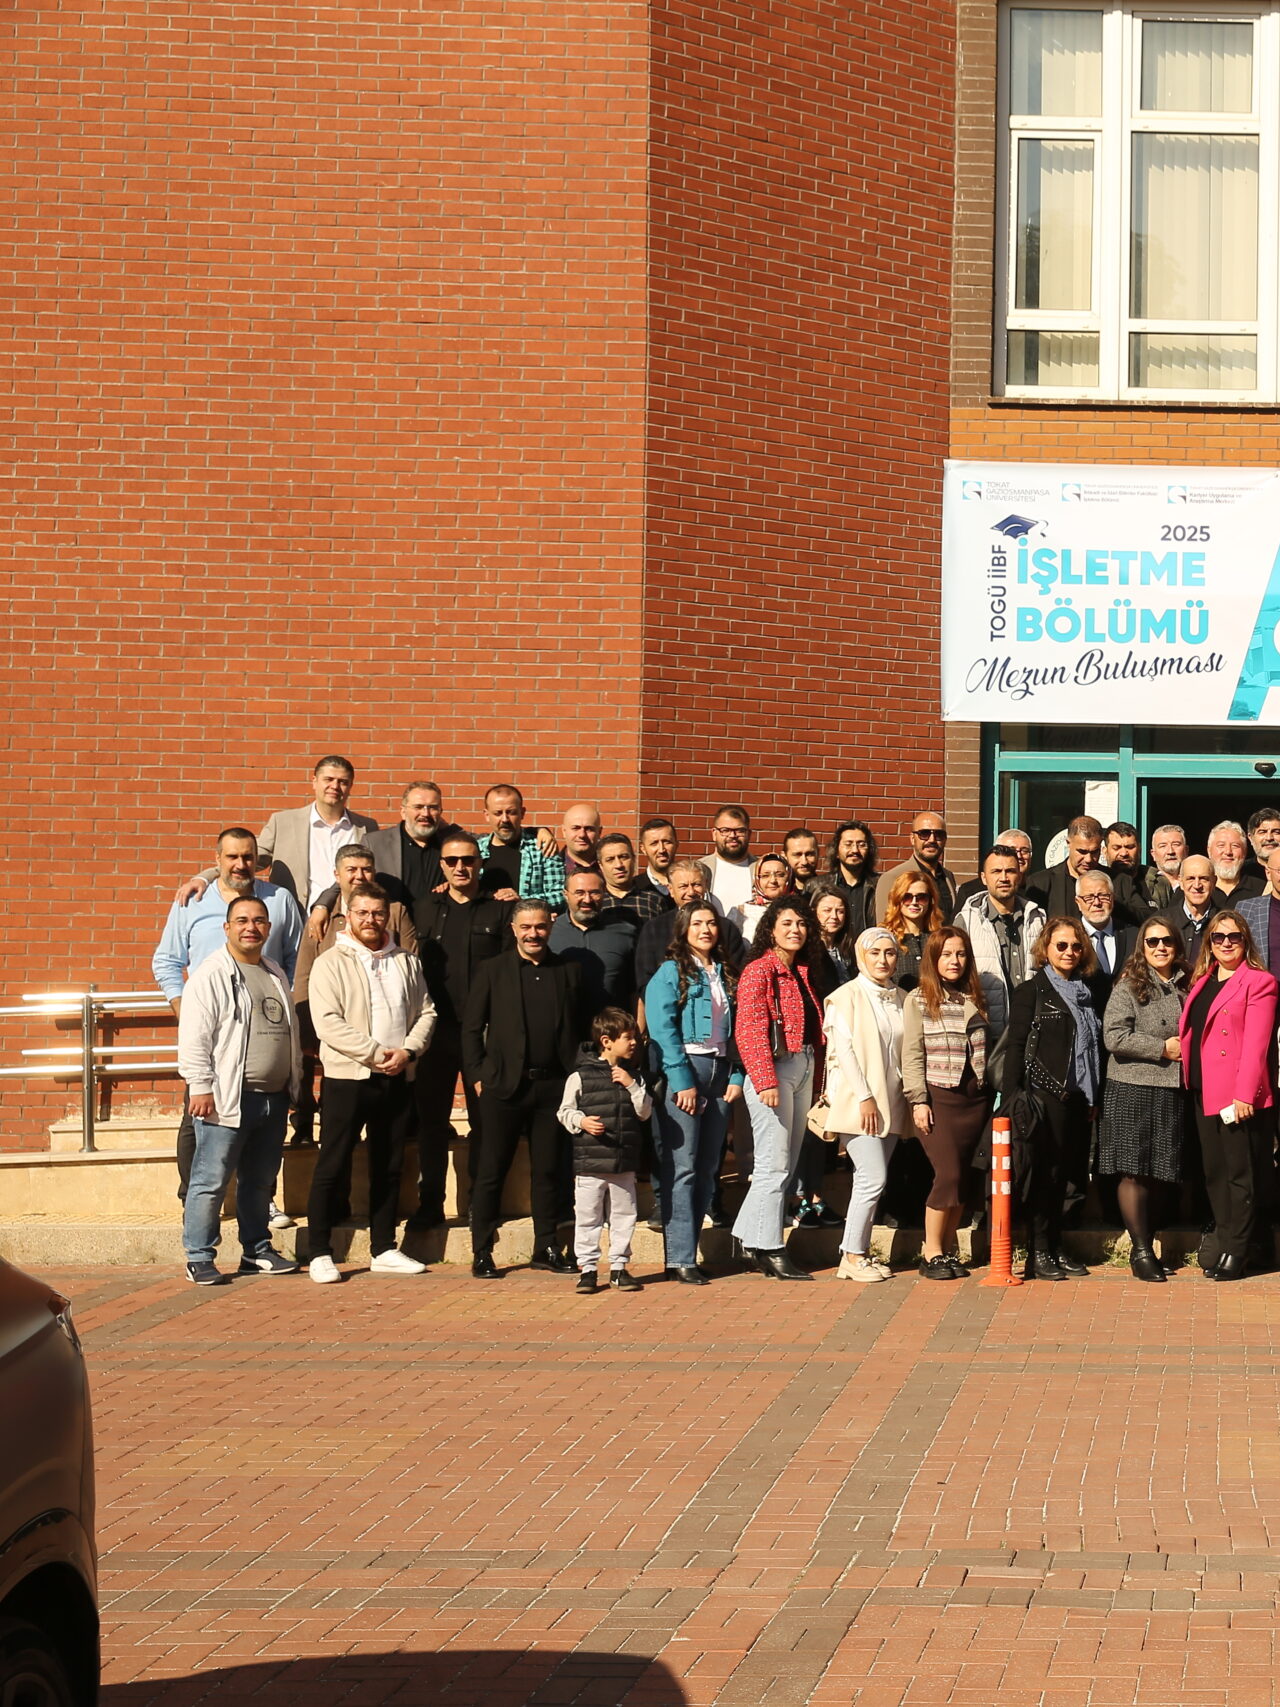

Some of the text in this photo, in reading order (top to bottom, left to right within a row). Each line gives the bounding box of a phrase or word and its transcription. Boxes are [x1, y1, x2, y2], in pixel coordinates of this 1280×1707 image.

[1160, 525, 1211, 542] 2025
[1017, 537, 1206, 595] İŞLETME
[987, 586, 1007, 642] TOGÜ
[1016, 597, 1209, 645] BÖLÜMÜ
[965, 648, 1228, 701] Mezun Buluşması
